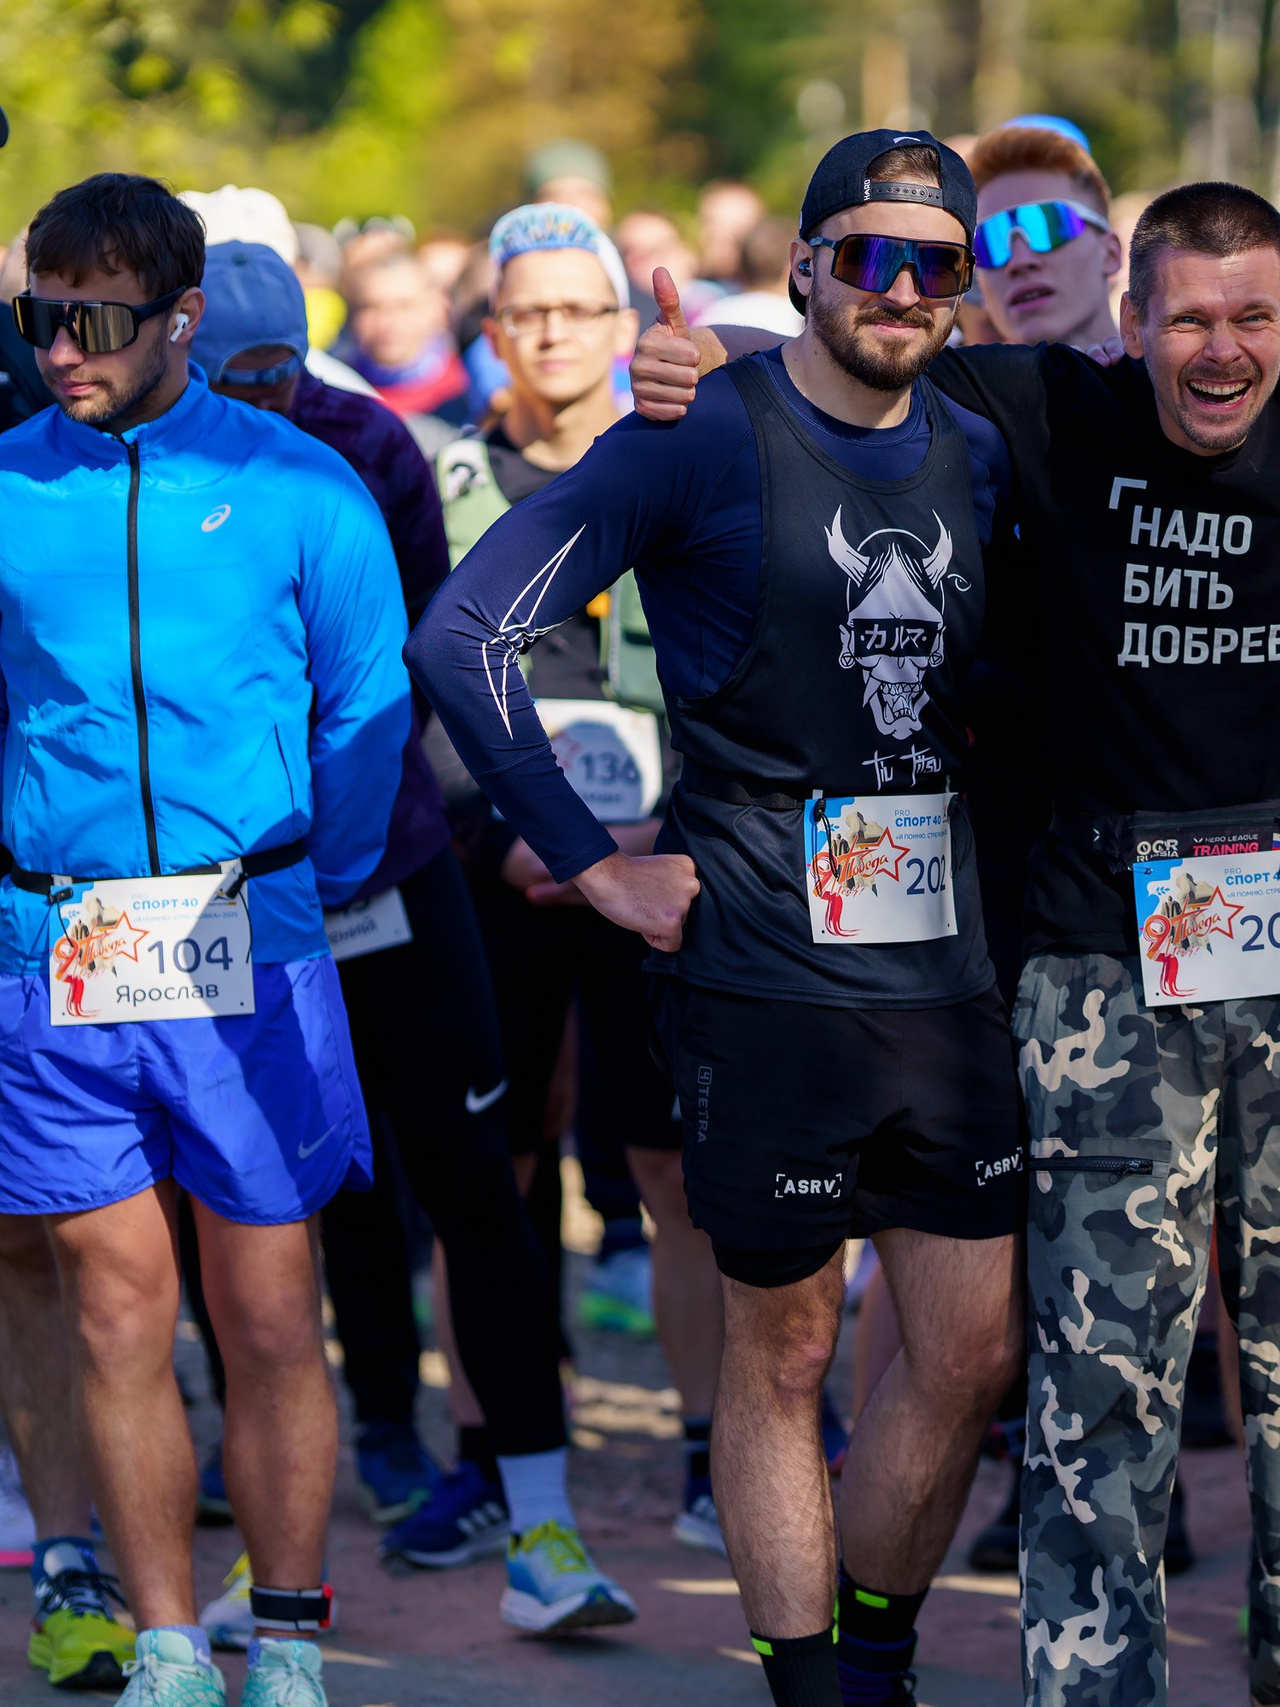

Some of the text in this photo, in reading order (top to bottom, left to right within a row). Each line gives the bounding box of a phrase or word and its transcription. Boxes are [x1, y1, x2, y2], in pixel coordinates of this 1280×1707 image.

[1130, 504, 1253, 559] НАДО
[1123, 563, 1234, 610] БИТЬ
[580, 753, 639, 784] 136
[895, 815, 942, 828] СПОРТ 40
[1227, 834, 1258, 842] LEAGUE
[1137, 839, 1179, 855] OCR
[1193, 842, 1259, 856] TRAINING
[1224, 867, 1241, 875] PRO
[1225, 872, 1270, 886] СПОРТ
[132, 899, 178, 910] СПОРТ
[182, 898, 198, 907] 40
[147, 936, 233, 974] 104
[116, 983, 219, 1007] Ярослав
[984, 1153, 1021, 1180] ASRV
[783, 1179, 837, 1194] ASRV
